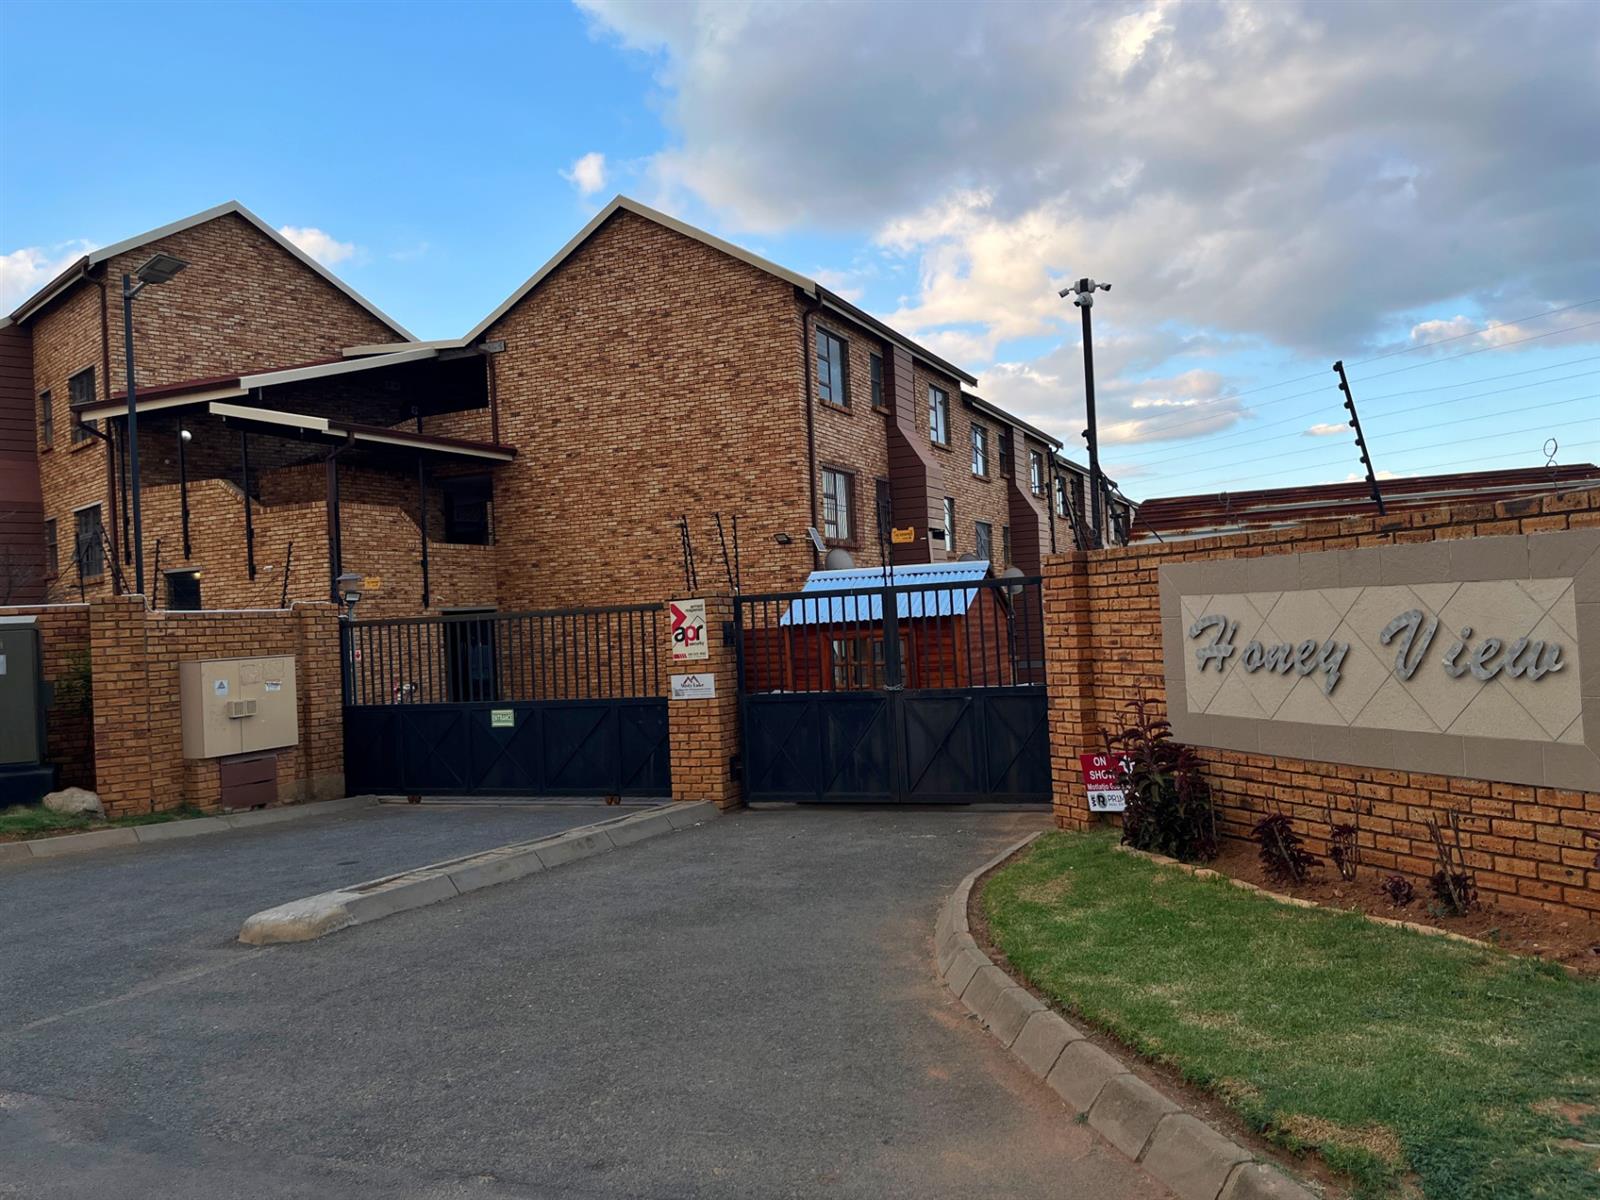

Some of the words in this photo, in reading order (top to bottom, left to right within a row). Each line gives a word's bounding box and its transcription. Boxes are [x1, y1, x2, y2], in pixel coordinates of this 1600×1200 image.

[674, 624, 704, 647] apr
[1188, 614, 1350, 697] Honey
[1379, 608, 1564, 682] View
[1093, 756, 1107, 767] ON
